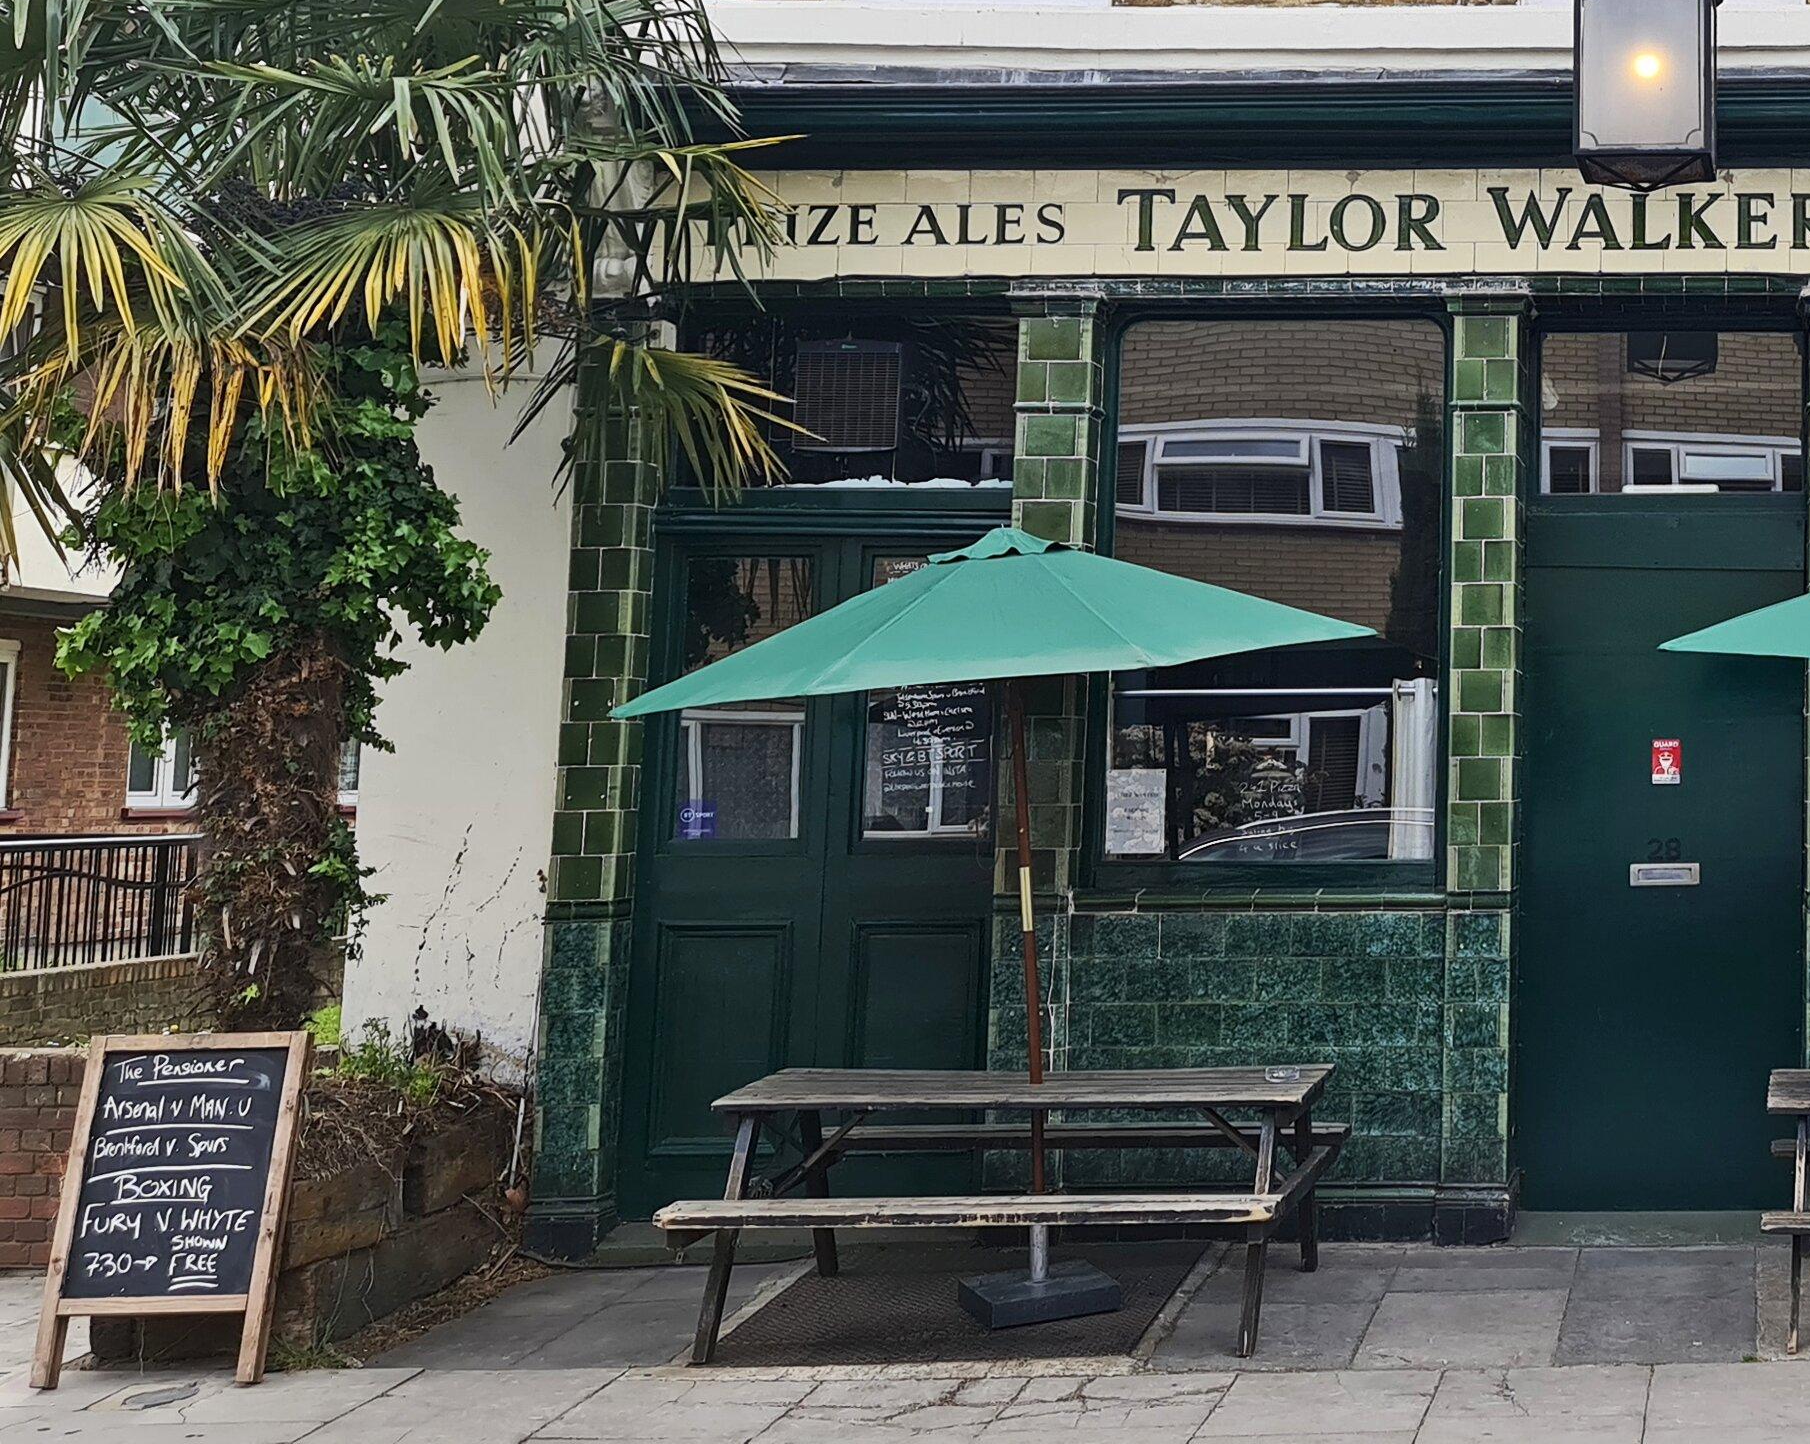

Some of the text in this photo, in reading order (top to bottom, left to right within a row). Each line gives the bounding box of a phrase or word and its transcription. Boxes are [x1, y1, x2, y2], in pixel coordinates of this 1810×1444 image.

[901, 204, 1066, 245] ALES
[1117, 188, 1447, 252] TAYLOR
[1241, 796, 1298, 813] Mondays
[114, 1054, 245, 1083] The Pensioner
[103, 1095, 165, 1123] Arsenal
[93, 1134, 160, 1159] Brentford
[188, 1133, 230, 1159] Spurs
[113, 1174, 213, 1204] BOXING
[80, 1203, 142, 1239] FURY
[180, 1208, 255, 1232] WHYTE
[170, 1235, 228, 1251] SHOWN
[168, 1253, 218, 1277] FREE
